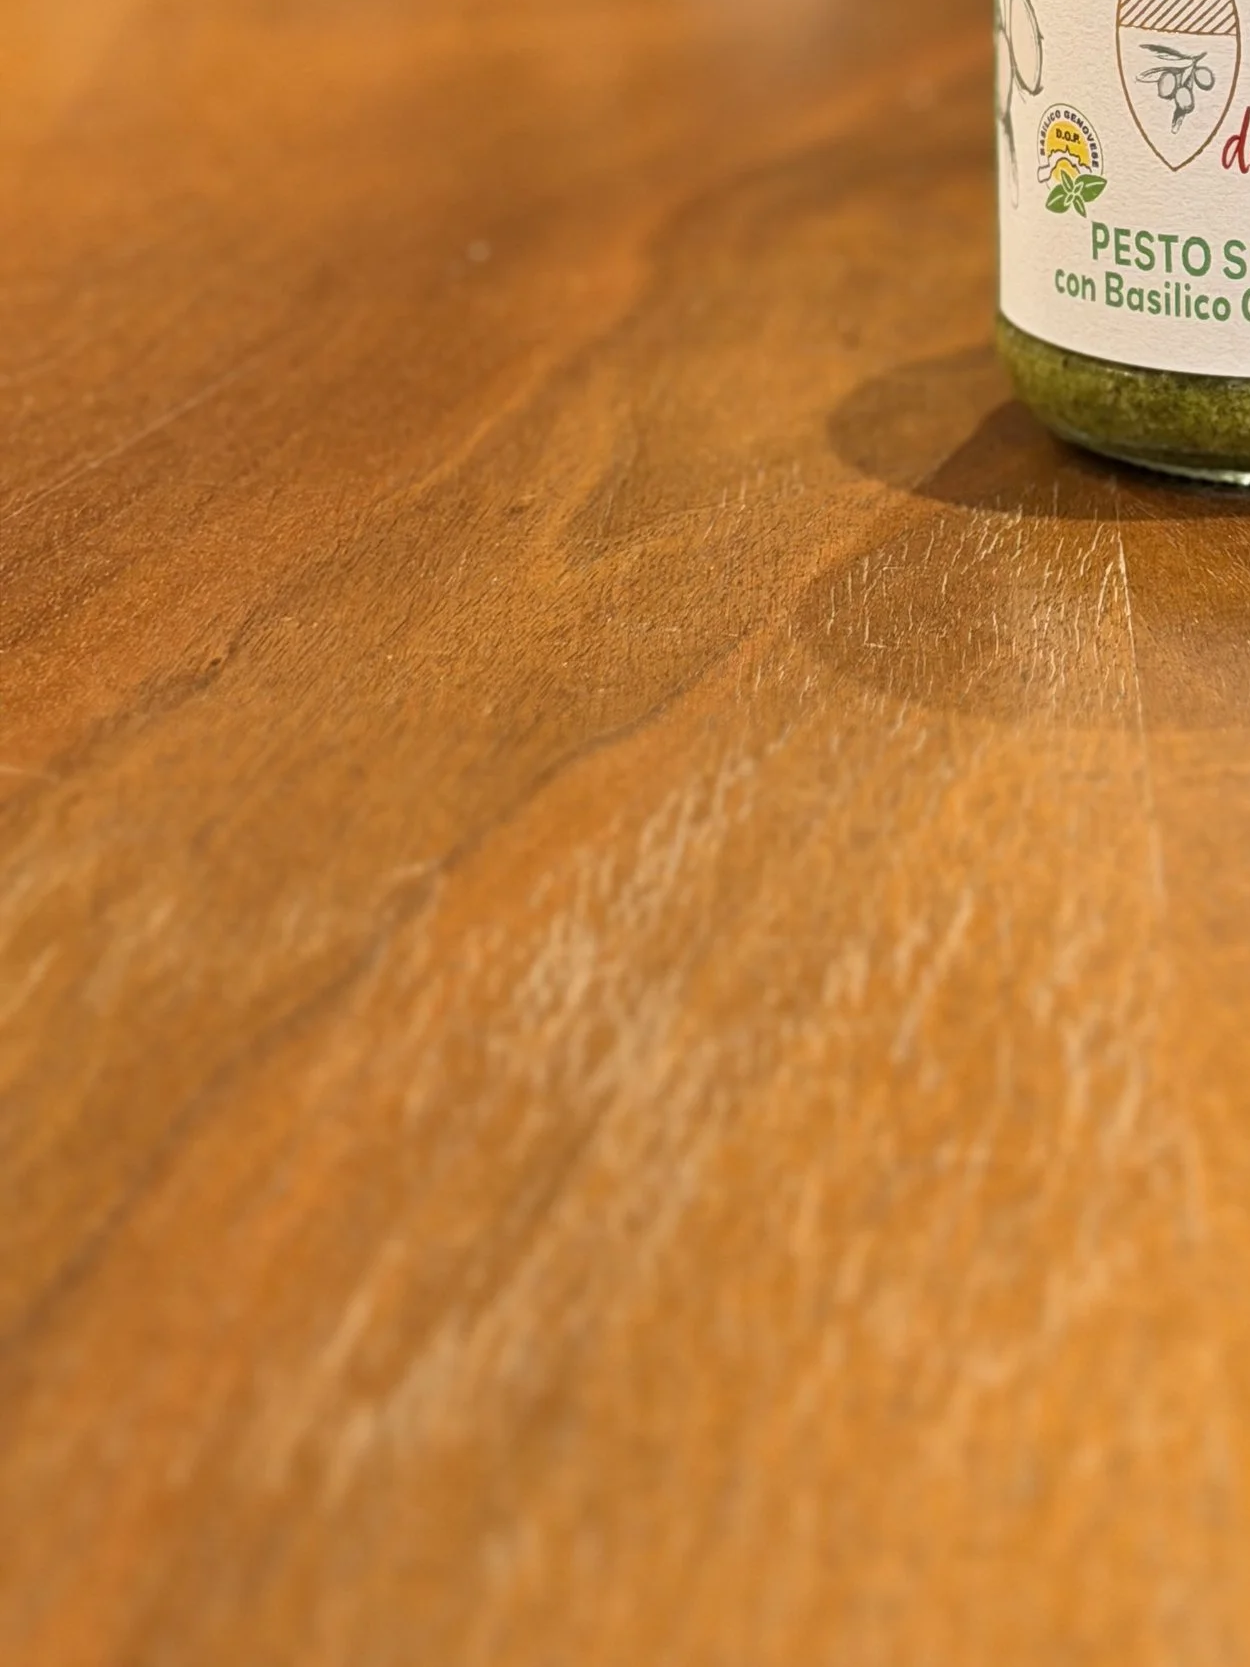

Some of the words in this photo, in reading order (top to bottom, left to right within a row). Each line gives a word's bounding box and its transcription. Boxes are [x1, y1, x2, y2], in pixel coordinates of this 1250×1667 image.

[1091, 221, 1212, 277] PESTO
[1054, 268, 1097, 302] con
[1105, 271, 1232, 322] Basilico
